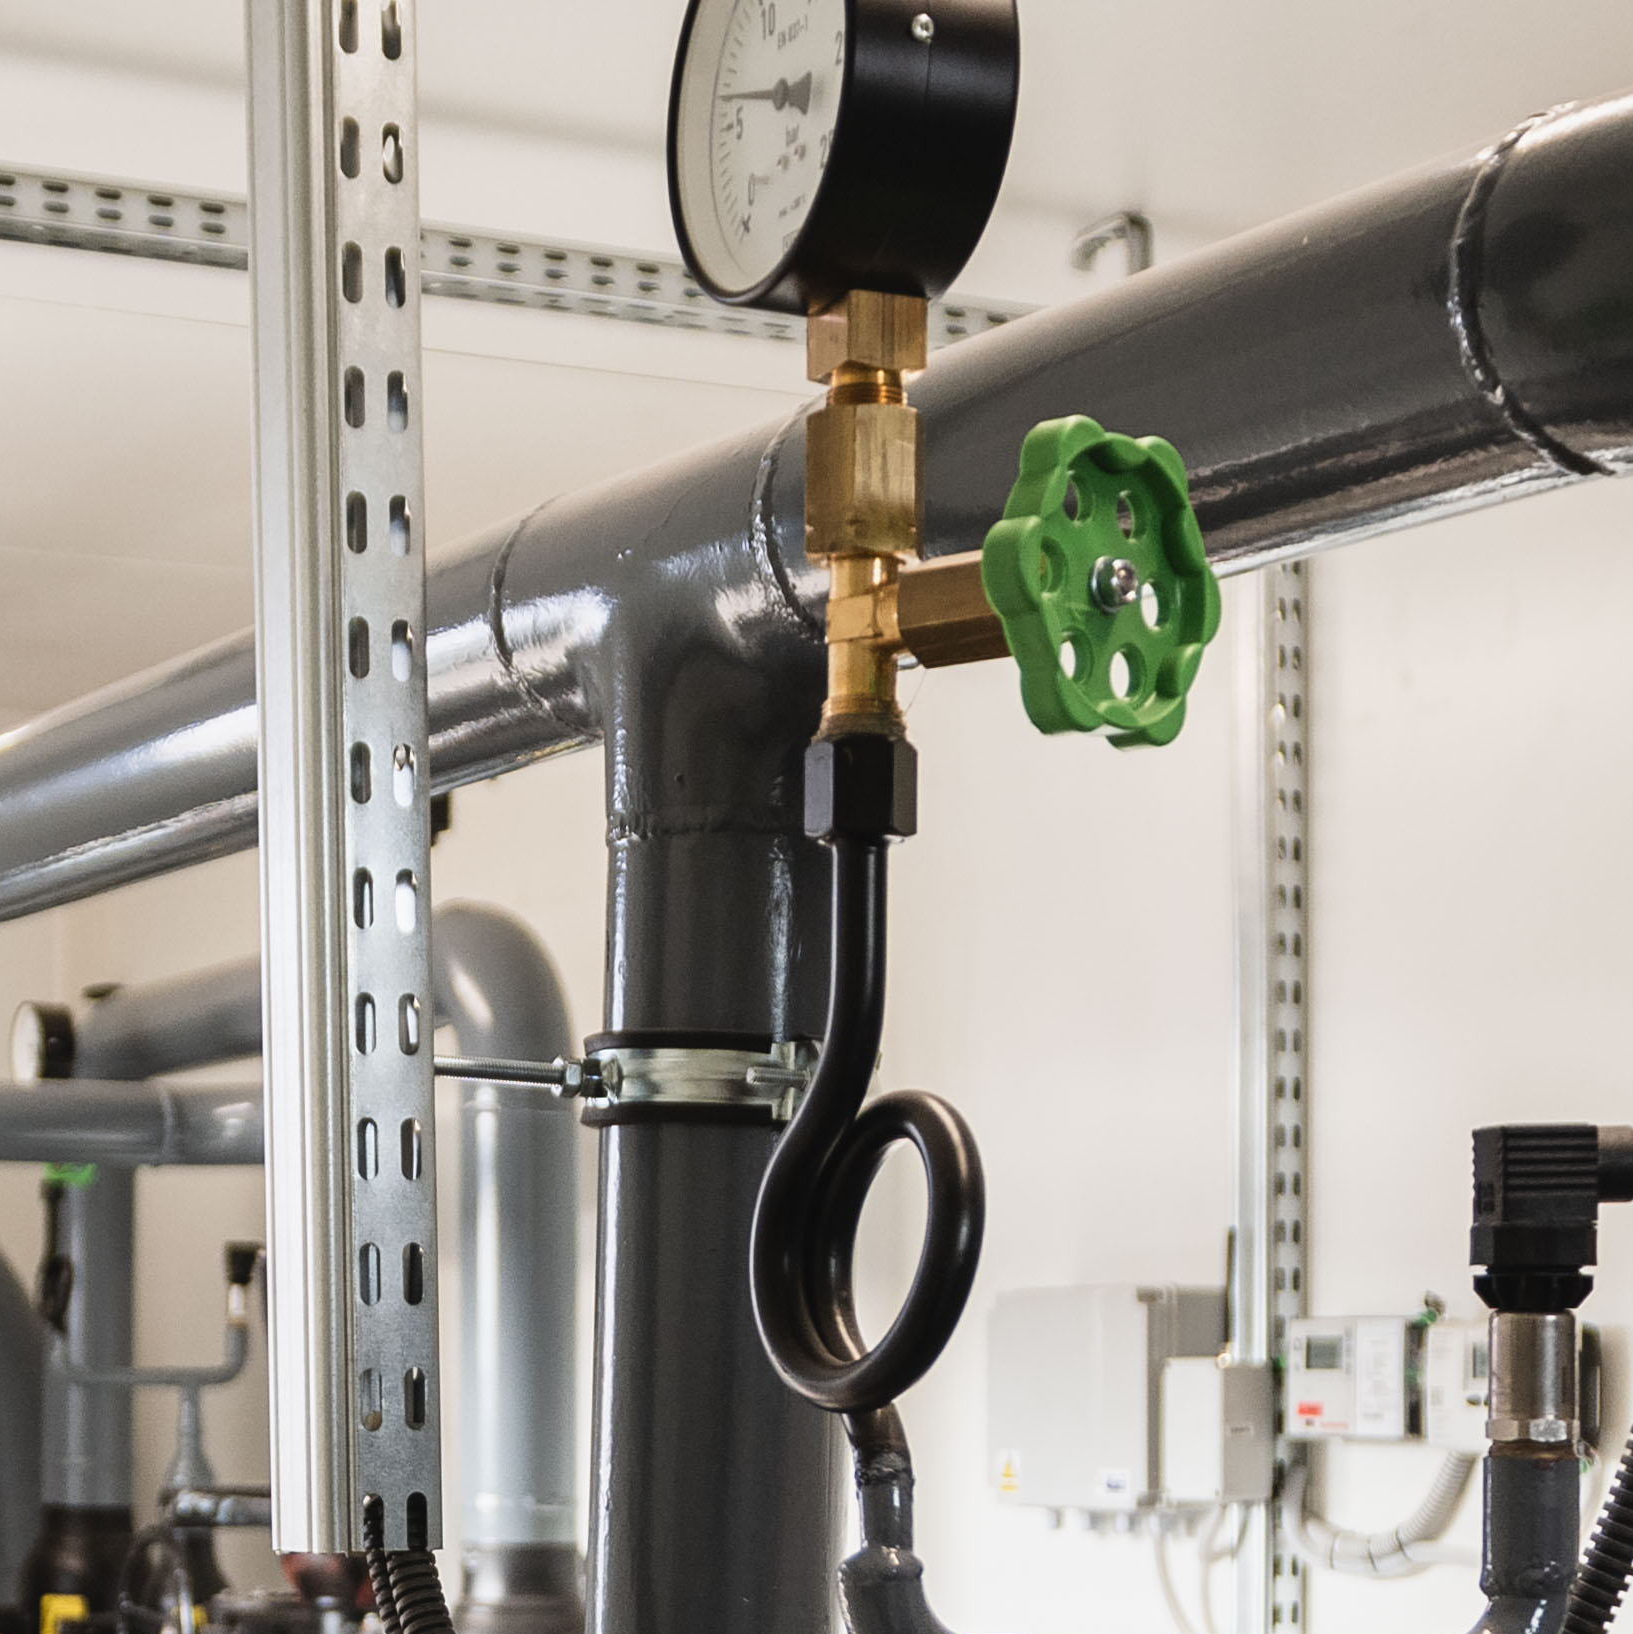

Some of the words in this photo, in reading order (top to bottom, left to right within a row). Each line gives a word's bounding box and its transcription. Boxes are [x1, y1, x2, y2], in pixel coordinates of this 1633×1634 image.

[761, 2, 776, 39] 10
[736, 105, 743, 140] 5
[748, 172, 755, 207] 0
